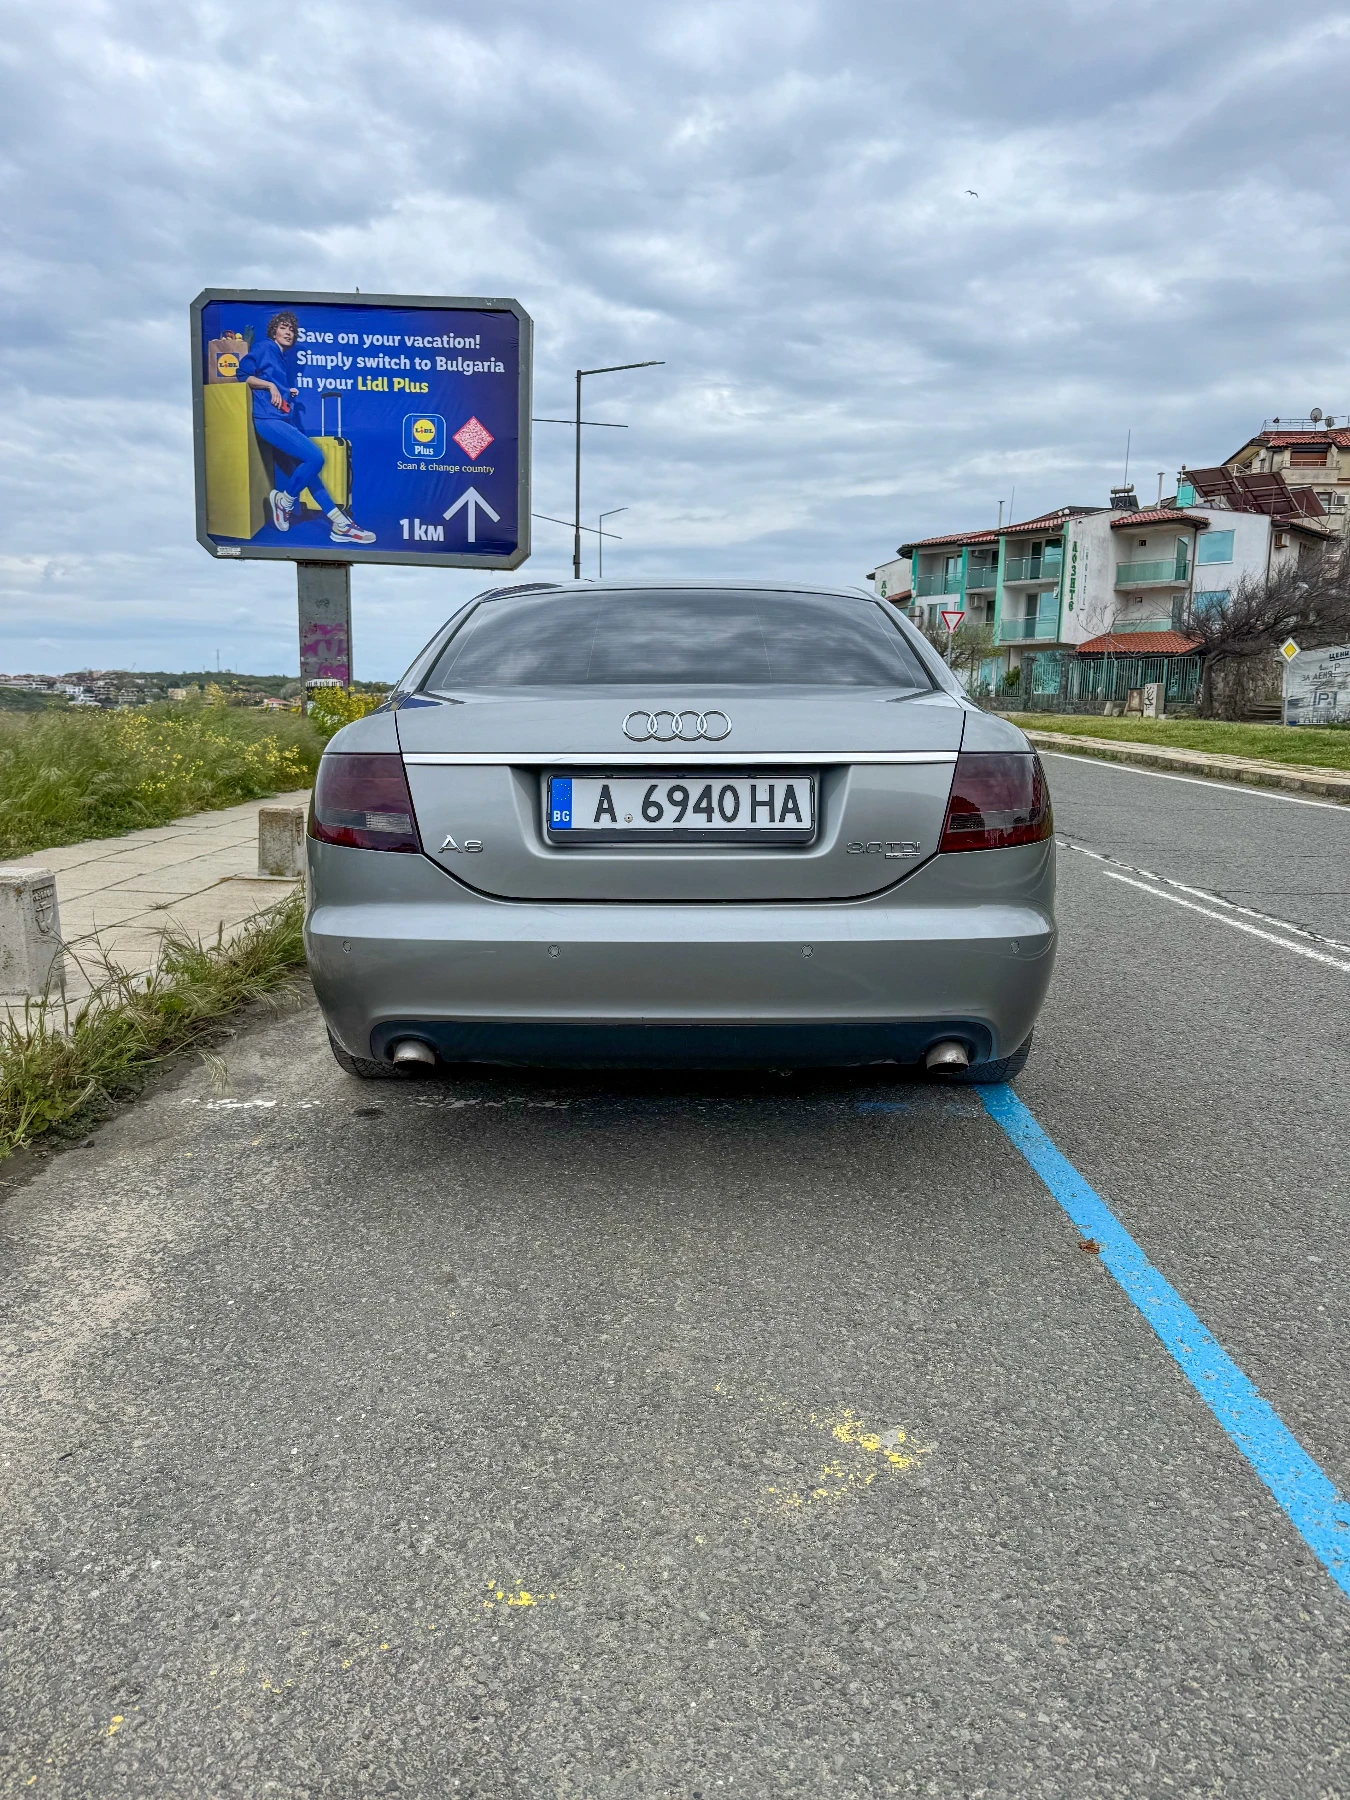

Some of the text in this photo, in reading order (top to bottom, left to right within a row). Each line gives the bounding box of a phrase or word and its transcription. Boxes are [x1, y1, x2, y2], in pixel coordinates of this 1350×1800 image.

[297, 328, 481, 349] Save on your vacation!
[296, 350, 505, 375] Simply switch to Bulgaria
[296, 372, 429, 393] in your Lidl Plus
[414, 445, 434, 455] Plus
[397, 460, 495, 475] Scan & change country
[399, 518, 409, 540] 1
[553, 811, 570, 822] BG
[885, 841, 921, 853] TDI
